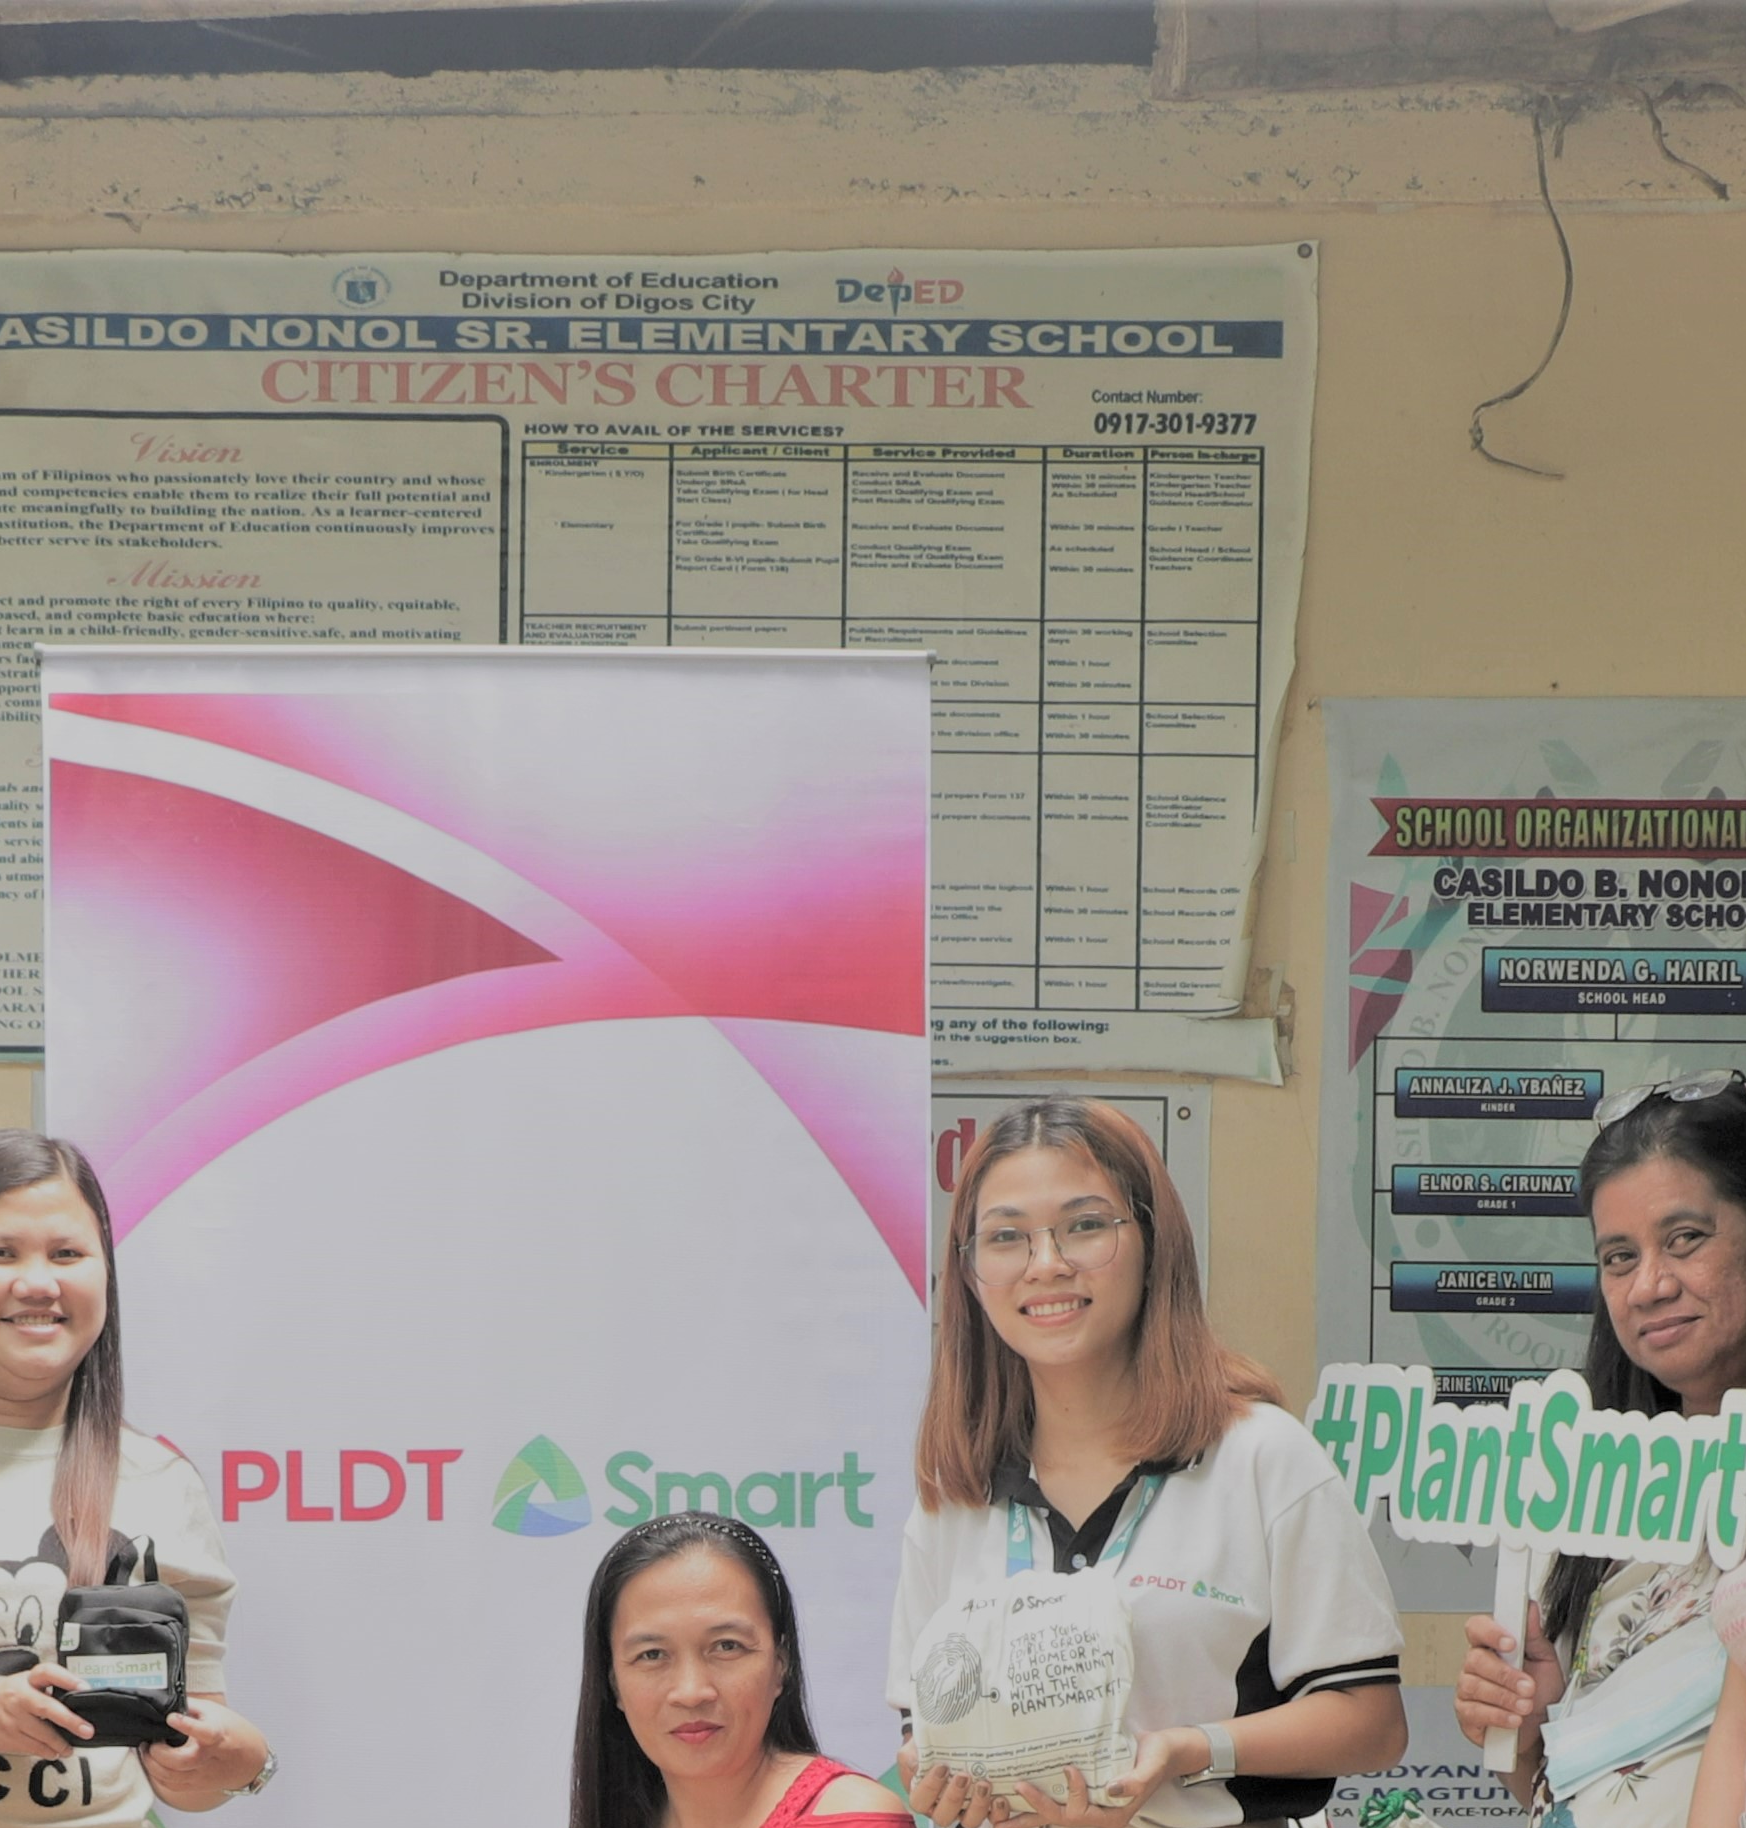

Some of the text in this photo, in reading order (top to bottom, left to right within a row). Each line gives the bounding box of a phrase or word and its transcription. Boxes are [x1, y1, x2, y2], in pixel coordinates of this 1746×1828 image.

[439, 270, 779, 290] Department of Education
[462, 288, 756, 315] Division of Digos City
[836, 269, 964, 316] DepED
[229, 319, 437, 349] NONOL
[455, 320, 548, 350] SR.
[568, 322, 973, 354] ELEMENTARY
[987, 323, 1234, 355] SCHOOL
[261, 359, 1035, 408] CITIZEN'S CHARTER
[1091, 389, 1203, 404] Contact Number:
[524, 423, 844, 437] HOW TO AVAIL OF THE SERVICES?
[1093, 412, 1257, 435] 0917-301-9377
[130, 432, 244, 464] Vision
[557, 443, 629, 455] Service
[691, 446, 768, 458] Applicant
[783, 446, 830, 457] Client
[872, 448, 1016, 459] Service Provided
[1062, 448, 1135, 459] Duration
[1150, 449, 1194, 459] Person
[21, 469, 39, 480] of
[42, 469, 112, 483] Filipinos
[116, 471, 149, 483] who
[153, 472, 250, 486] passionately
[255, 473, 287, 484] love
[292, 472, 331, 484] their
[334, 475, 397, 487] country
[402, 474, 432, 486] and
[436, 474, 486, 486] whose
[22, 487, 128, 499] competencies
[132, 488, 184, 500] enable
[189, 489, 229, 500] them
[234, 490, 250, 500] to
[254, 488, 307, 500] realize
[311, 489, 350, 501] their
[354, 489, 381, 501] full
[385, 491, 457, 504] potential
[461, 491, 491, 502] and
[21, 503, 125, 516] meaningfully
[130, 505, 146, 515] to
[150, 504, 217, 518] building
[221, 505, 246, 516] the
[250, 505, 305, 516] nation.
[310, 505, 331, 517] As
[336, 508, 345, 517] a
[349, 506, 482, 518] learner-centered
[78, 518, 104, 530] the
[108, 519, 204, 533] Department
[208, 521, 226, 532] of
[230, 521, 310, 532] Education
[315, 522, 417, 536] continuously
[421, 522, 495, 535] improves
[48, 537, 90, 546] serve
[94, 535, 113, 547] its
[117, 536, 222, 548] stakeholders.
[106, 561, 261, 589] Mission
[1395, 806, 1507, 849] SCHOOL
[1433, 868, 1587, 897] CASILDO
[1595, 869, 1628, 897] B.
[1467, 904, 1658, 928] ELEMENTARY
[1499, 958, 1742, 984] NORWENDA G. HAIRIL
[1578, 991, 1667, 1005] SCHOOL HEAD
[949, 1018, 1110, 1034] any of the following:
[950, 1033, 971, 1042] the
[975, 1034, 1049, 1044] suggestion
[1053, 1034, 1081, 1043] box.
[1410, 1074, 1585, 1096] ANNALIZA J. YBAÑEZ
[1480, 1102, 1515, 1112] KINDER
[1420, 1174, 1574, 1193] ELNOR S. CIRUNAY
[1477, 1199, 1506, 1209] GRADE
[1436, 1271, 1552, 1289] JANICE V. LIM
[1475, 1296, 1505, 1306] GRADE
[221, 1448, 464, 1522] PLDT
[603, 1450, 877, 1529] Smart
[1146, 1575, 1187, 1592] PLDT
[1209, 1586, 1246, 1607] Smart
